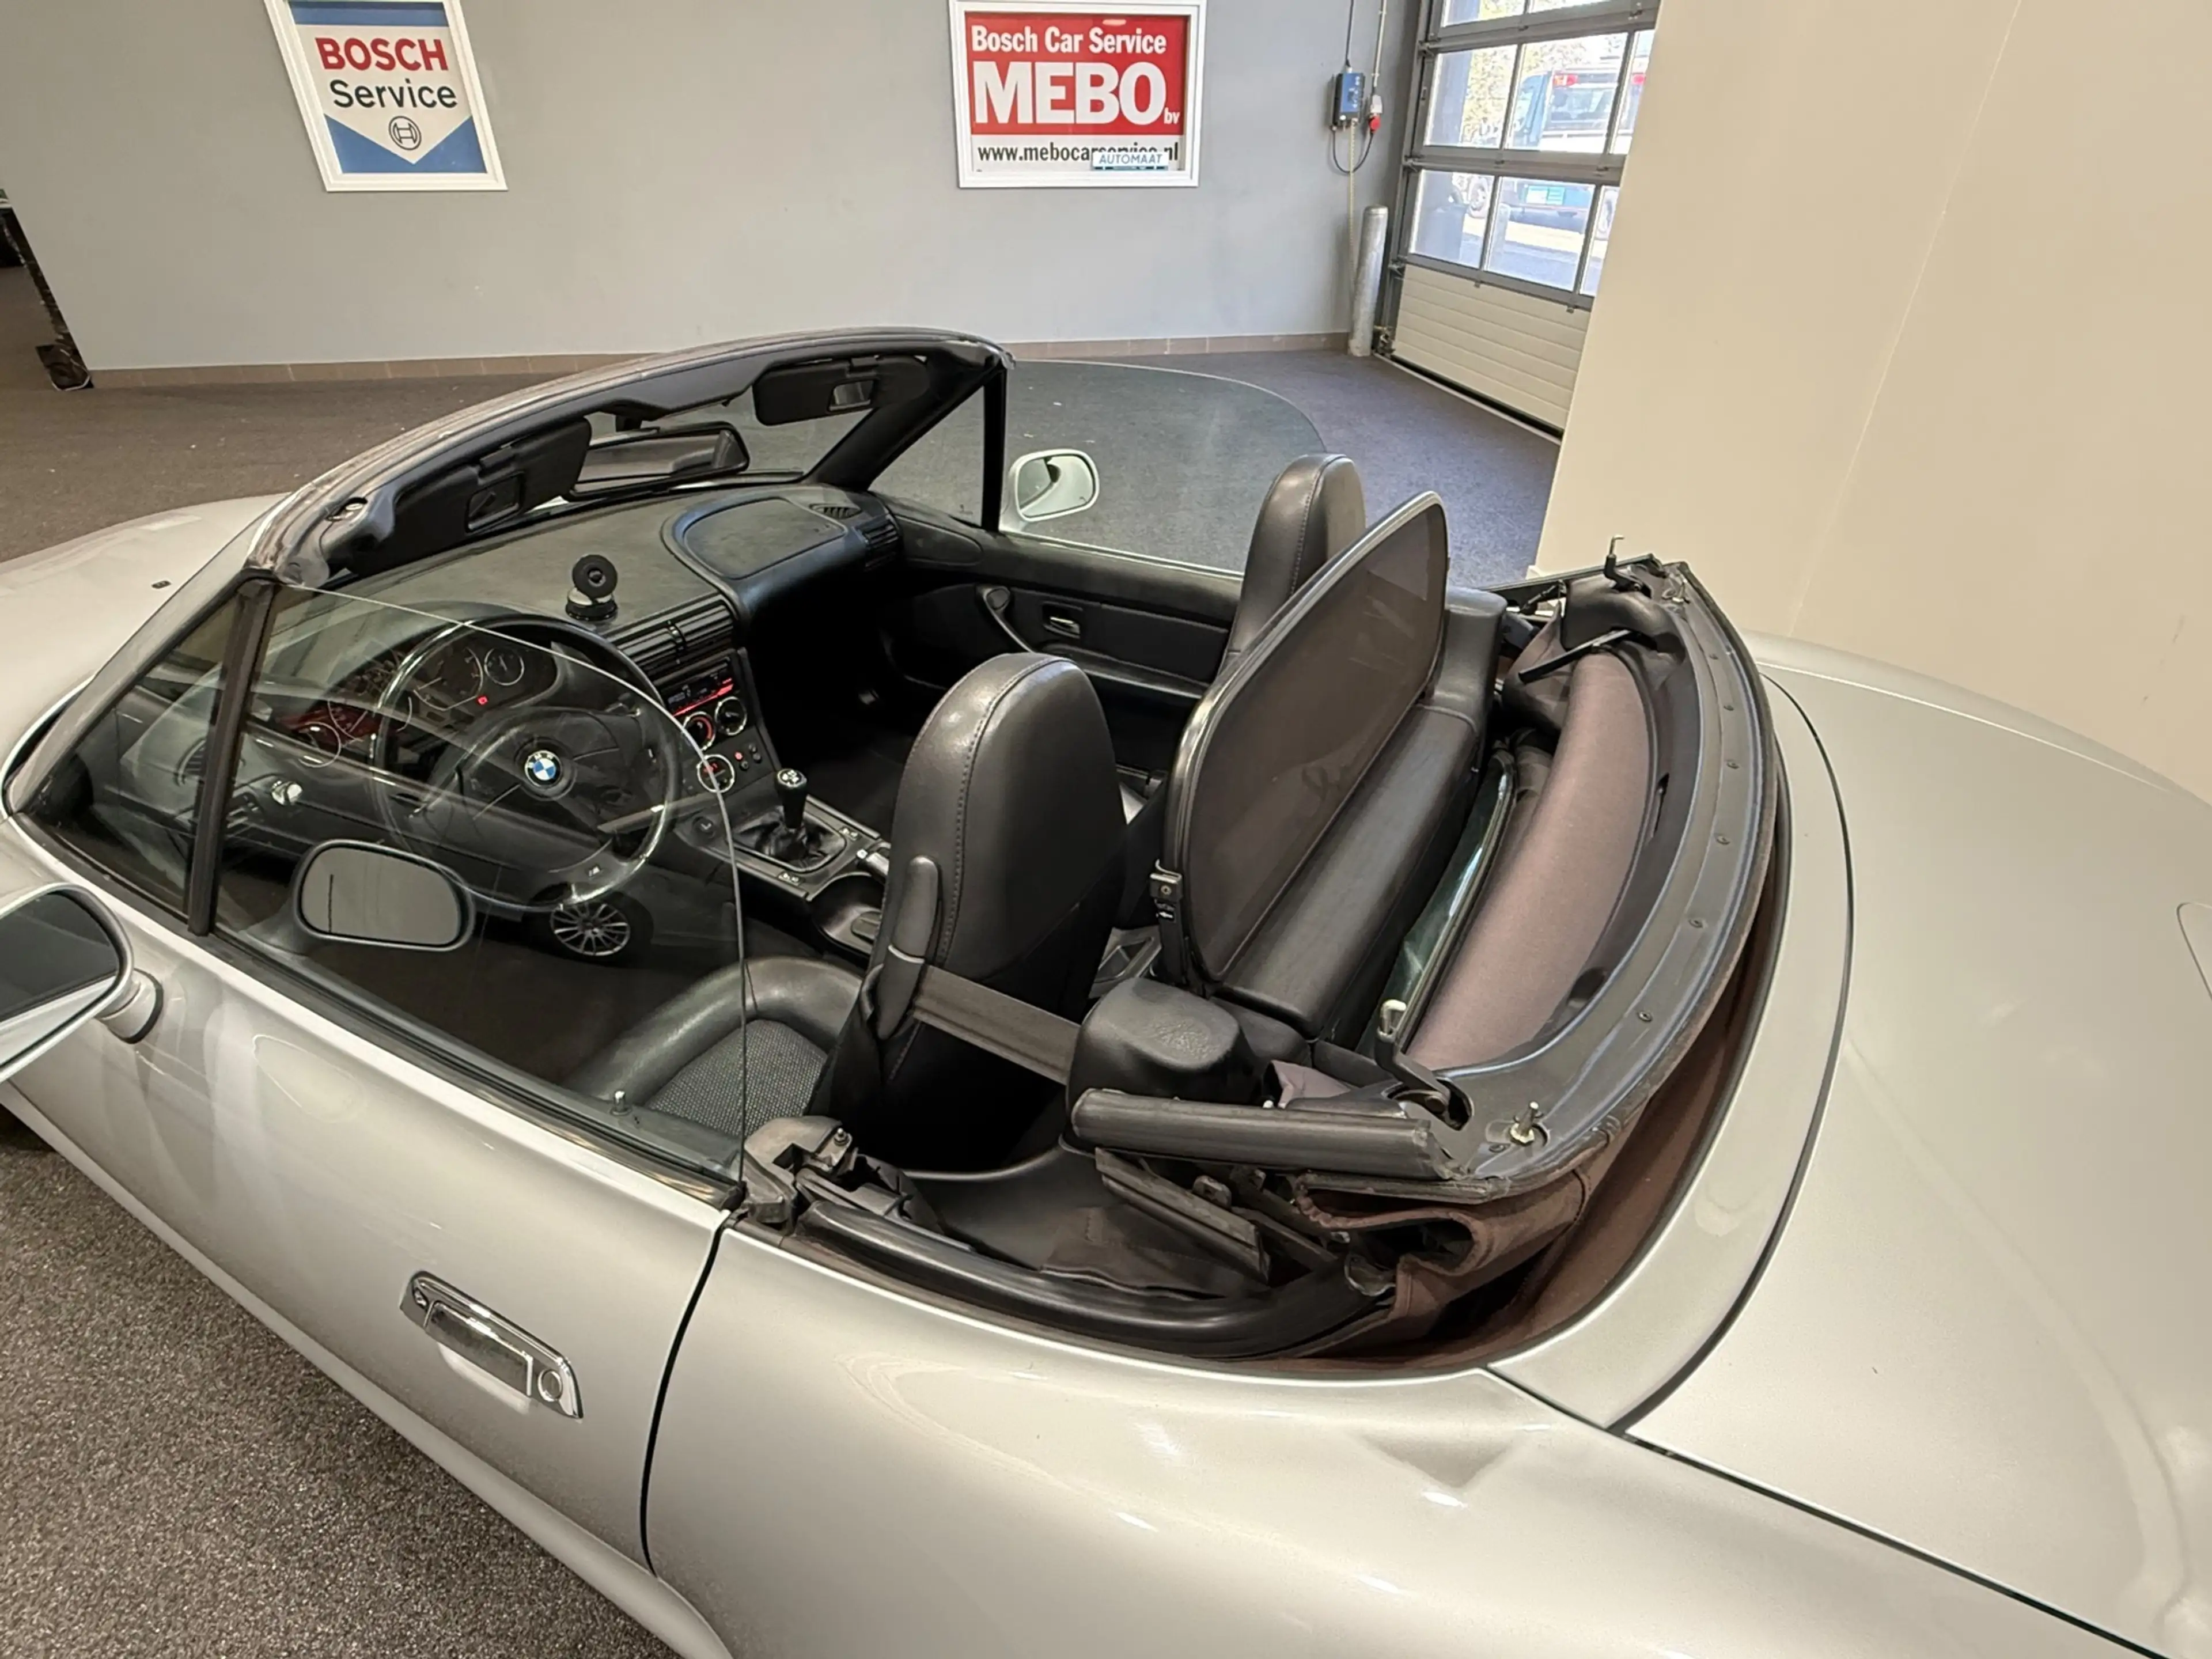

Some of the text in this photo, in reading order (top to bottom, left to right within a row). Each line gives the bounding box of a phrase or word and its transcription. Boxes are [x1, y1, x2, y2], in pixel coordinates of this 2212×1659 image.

[316, 37, 448, 71] BOSCH
[971, 25, 1166, 54] Bosch Car Service
[329, 78, 457, 108] Service
[973, 60, 1180, 125] MEBO bv
[1099, 154, 1162, 165] AUTOMAAT
